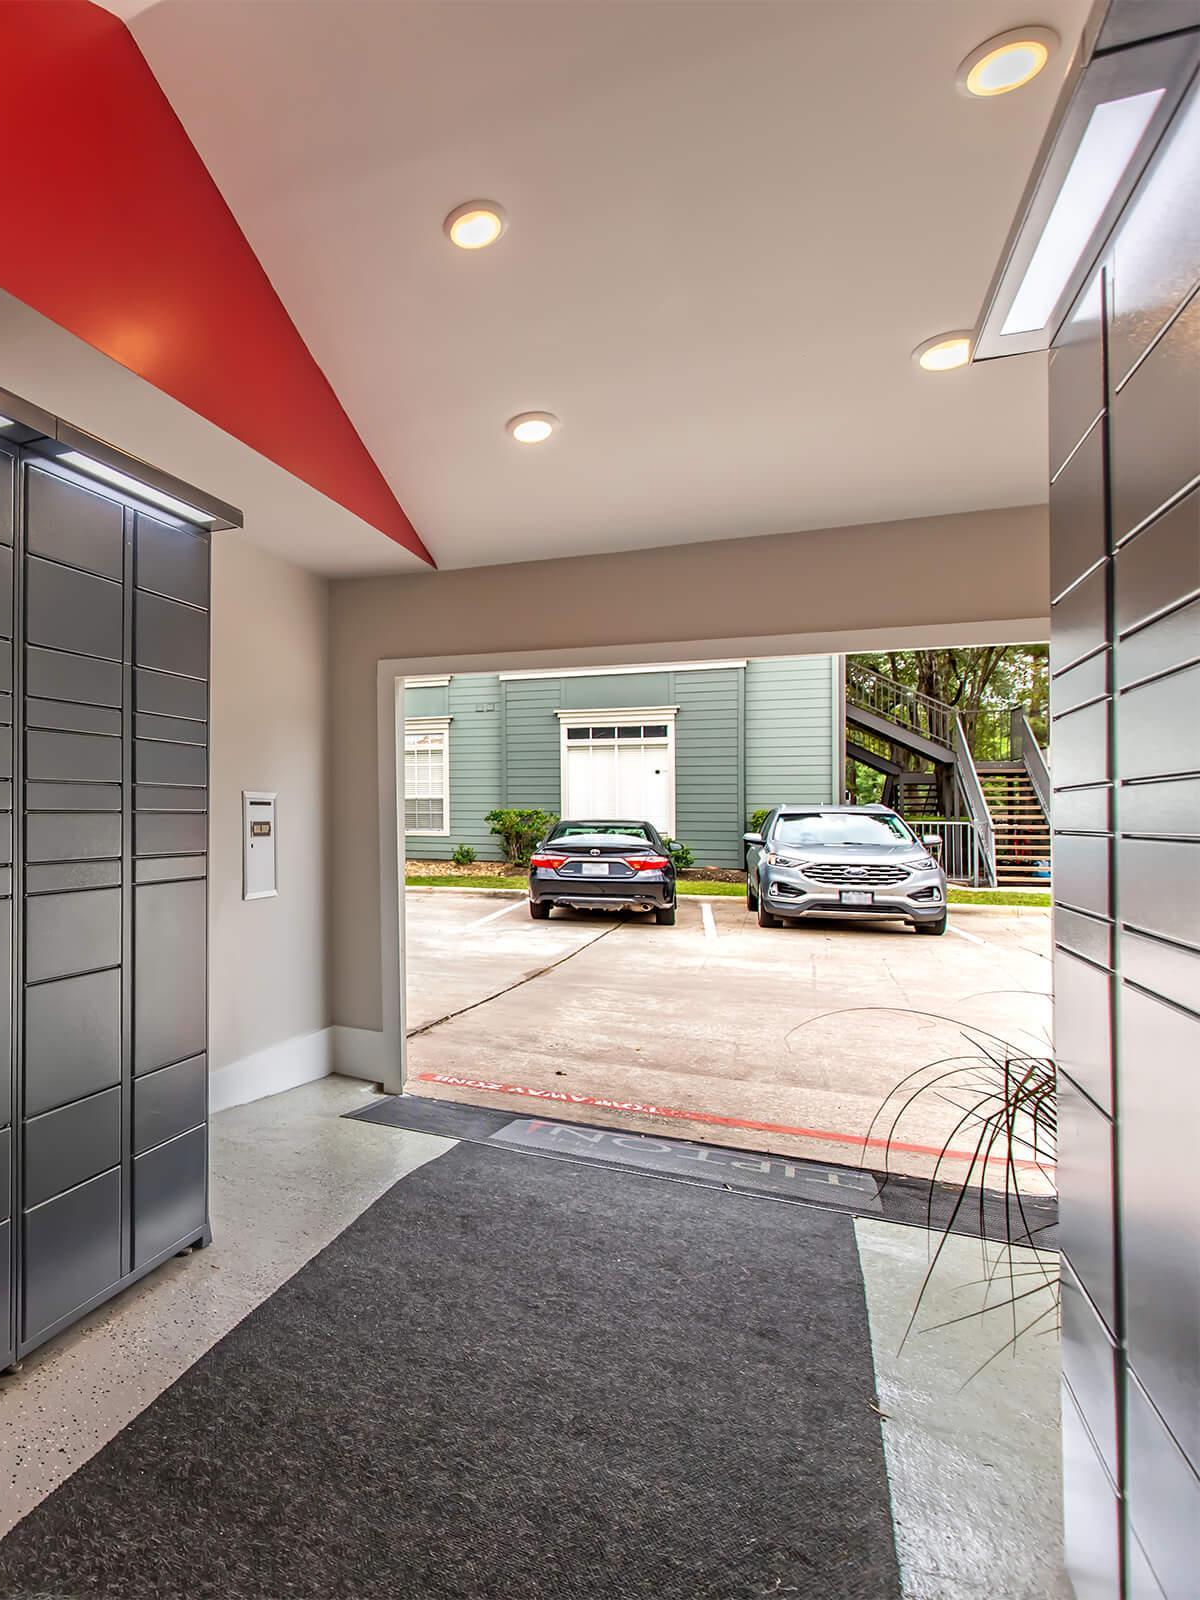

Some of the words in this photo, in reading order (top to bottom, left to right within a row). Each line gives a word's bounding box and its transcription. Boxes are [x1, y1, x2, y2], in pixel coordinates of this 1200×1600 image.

[432, 1075, 502, 1089] ZONE
[508, 1088, 587, 1101] AWAY
[594, 1100, 659, 1113] TOW
[550, 1126, 864, 1191] TIPTON
